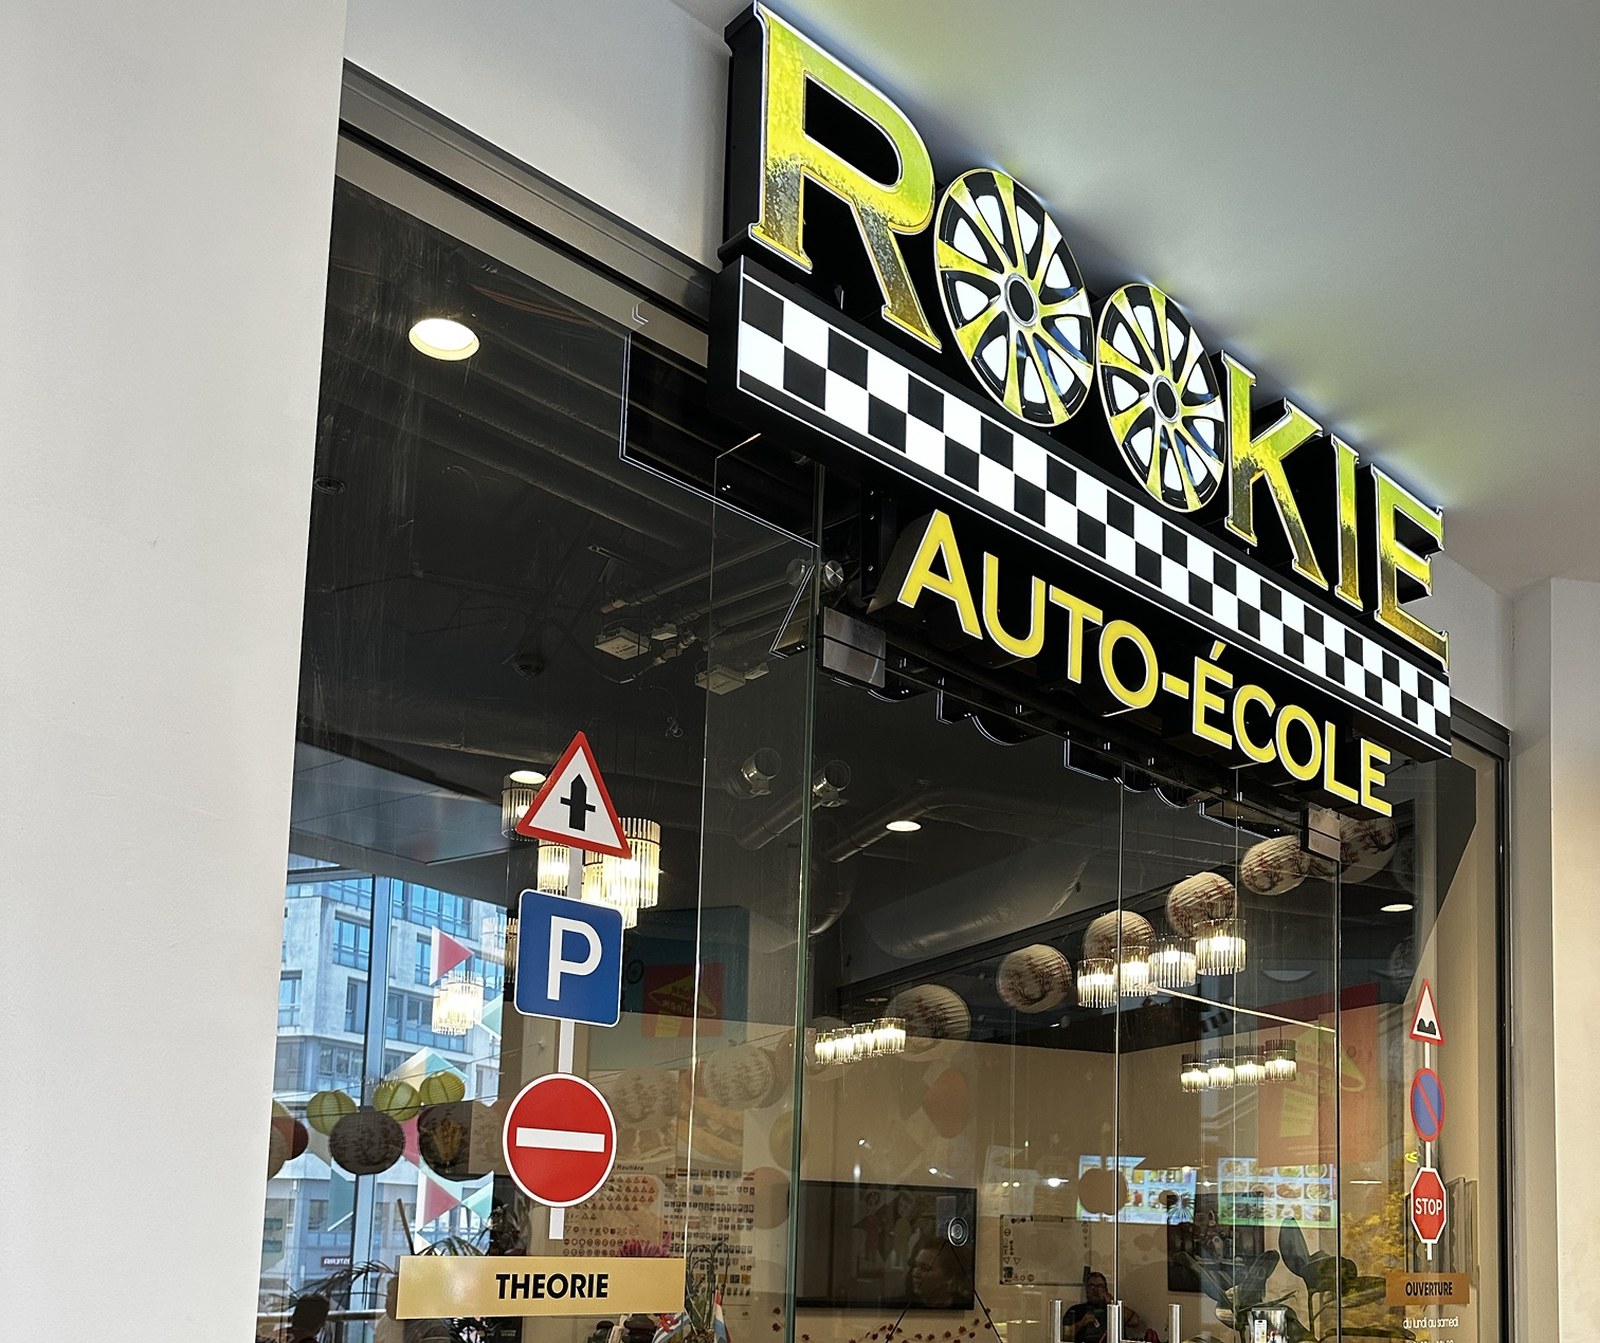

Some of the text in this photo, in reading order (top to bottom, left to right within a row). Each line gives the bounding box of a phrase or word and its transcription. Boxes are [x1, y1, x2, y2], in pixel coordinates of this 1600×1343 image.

[749, 1, 1450, 672] ROOKIE
[898, 508, 1393, 818] AUTO-ÉCOLE
[546, 914, 603, 1002] P
[1415, 1197, 1443, 1216] STOP
[495, 1272, 609, 1300] THEORIE
[1405, 1281, 1453, 1296] OUVERTURE
[1403, 1316, 1459, 1329] du lundi au samedi
